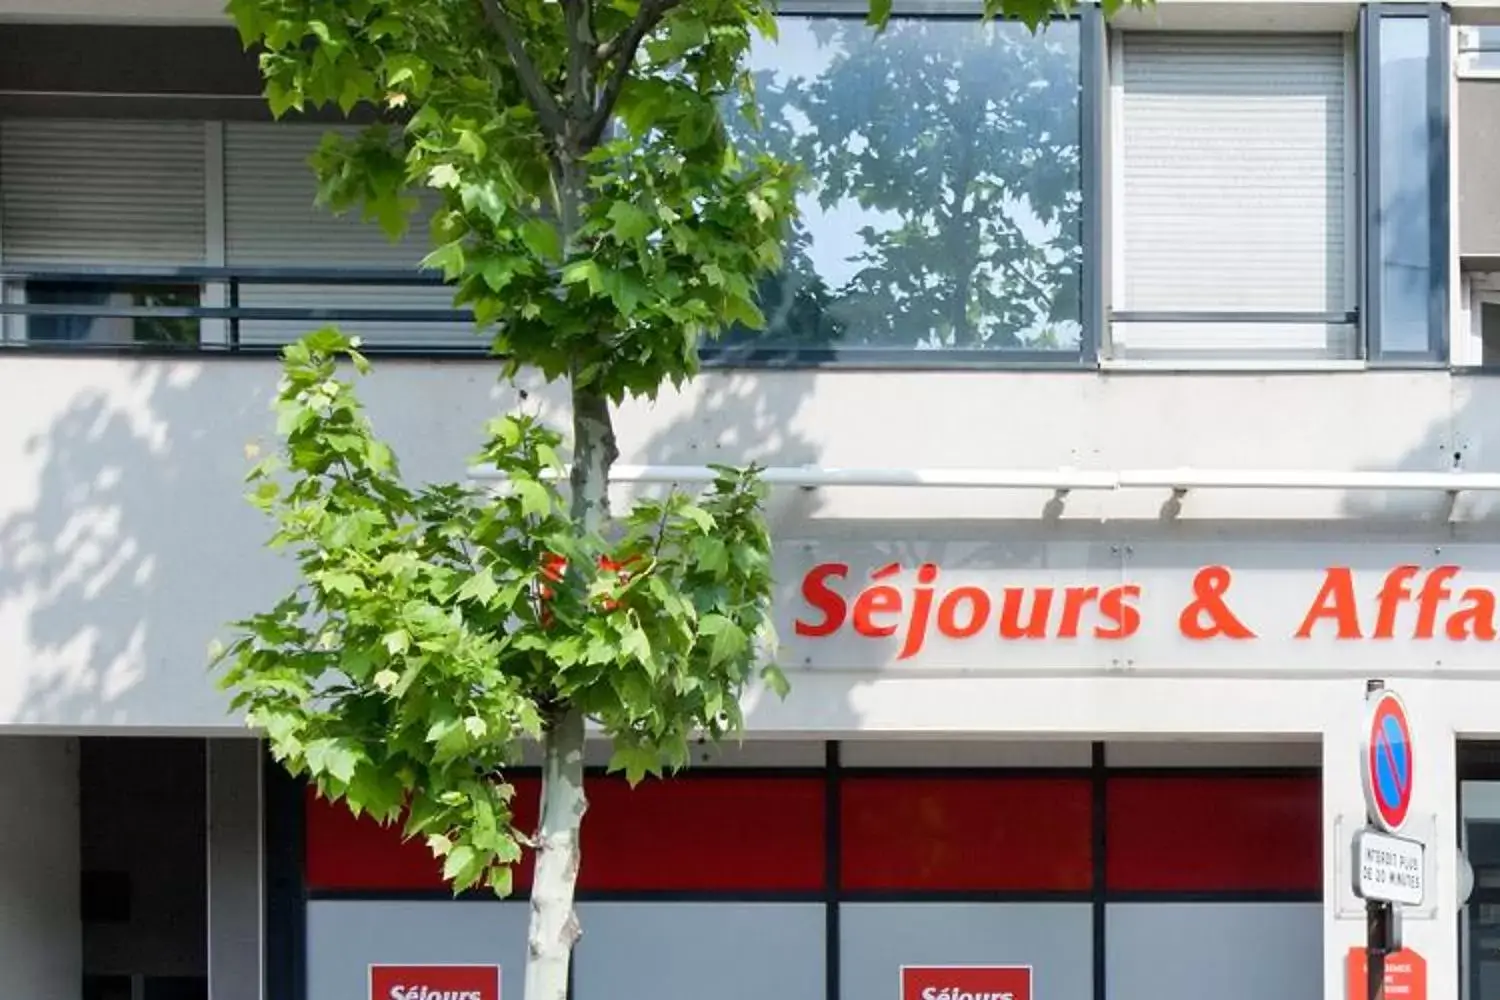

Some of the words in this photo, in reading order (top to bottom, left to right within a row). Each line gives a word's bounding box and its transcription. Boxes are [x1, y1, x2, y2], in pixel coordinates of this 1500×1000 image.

[797, 562, 1140, 659] Séjours
[1179, 565, 1253, 640] &
[1389, 870, 1420, 889] MINUTES
